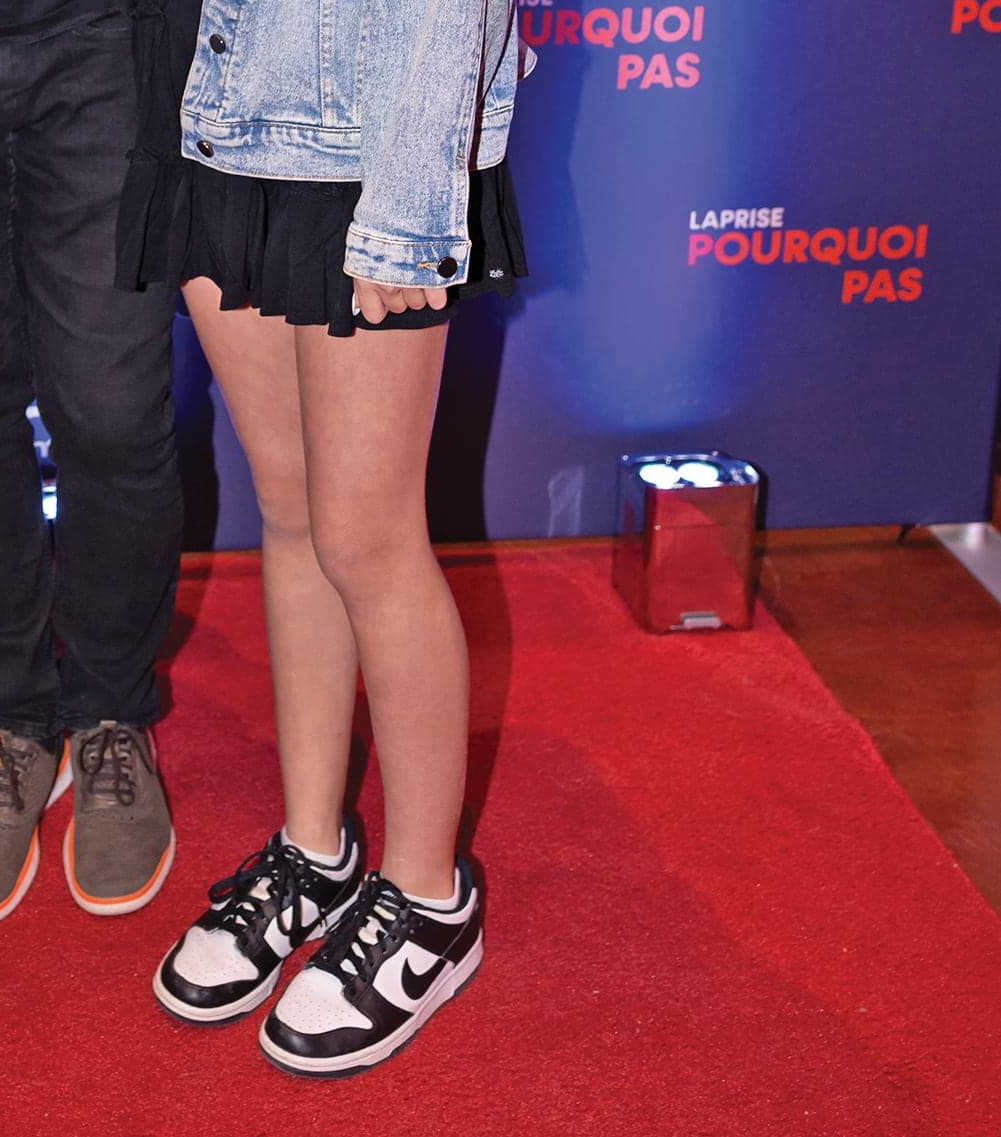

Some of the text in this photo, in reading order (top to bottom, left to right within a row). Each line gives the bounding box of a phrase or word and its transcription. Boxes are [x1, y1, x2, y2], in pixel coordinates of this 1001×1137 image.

[523, 6, 704, 48] URQUOI
[617, 53, 700, 89] PAS
[690, 209, 783, 229] LAPRISE
[688, 225, 927, 264] POURQUOI
[842, 268, 921, 304] PAS
